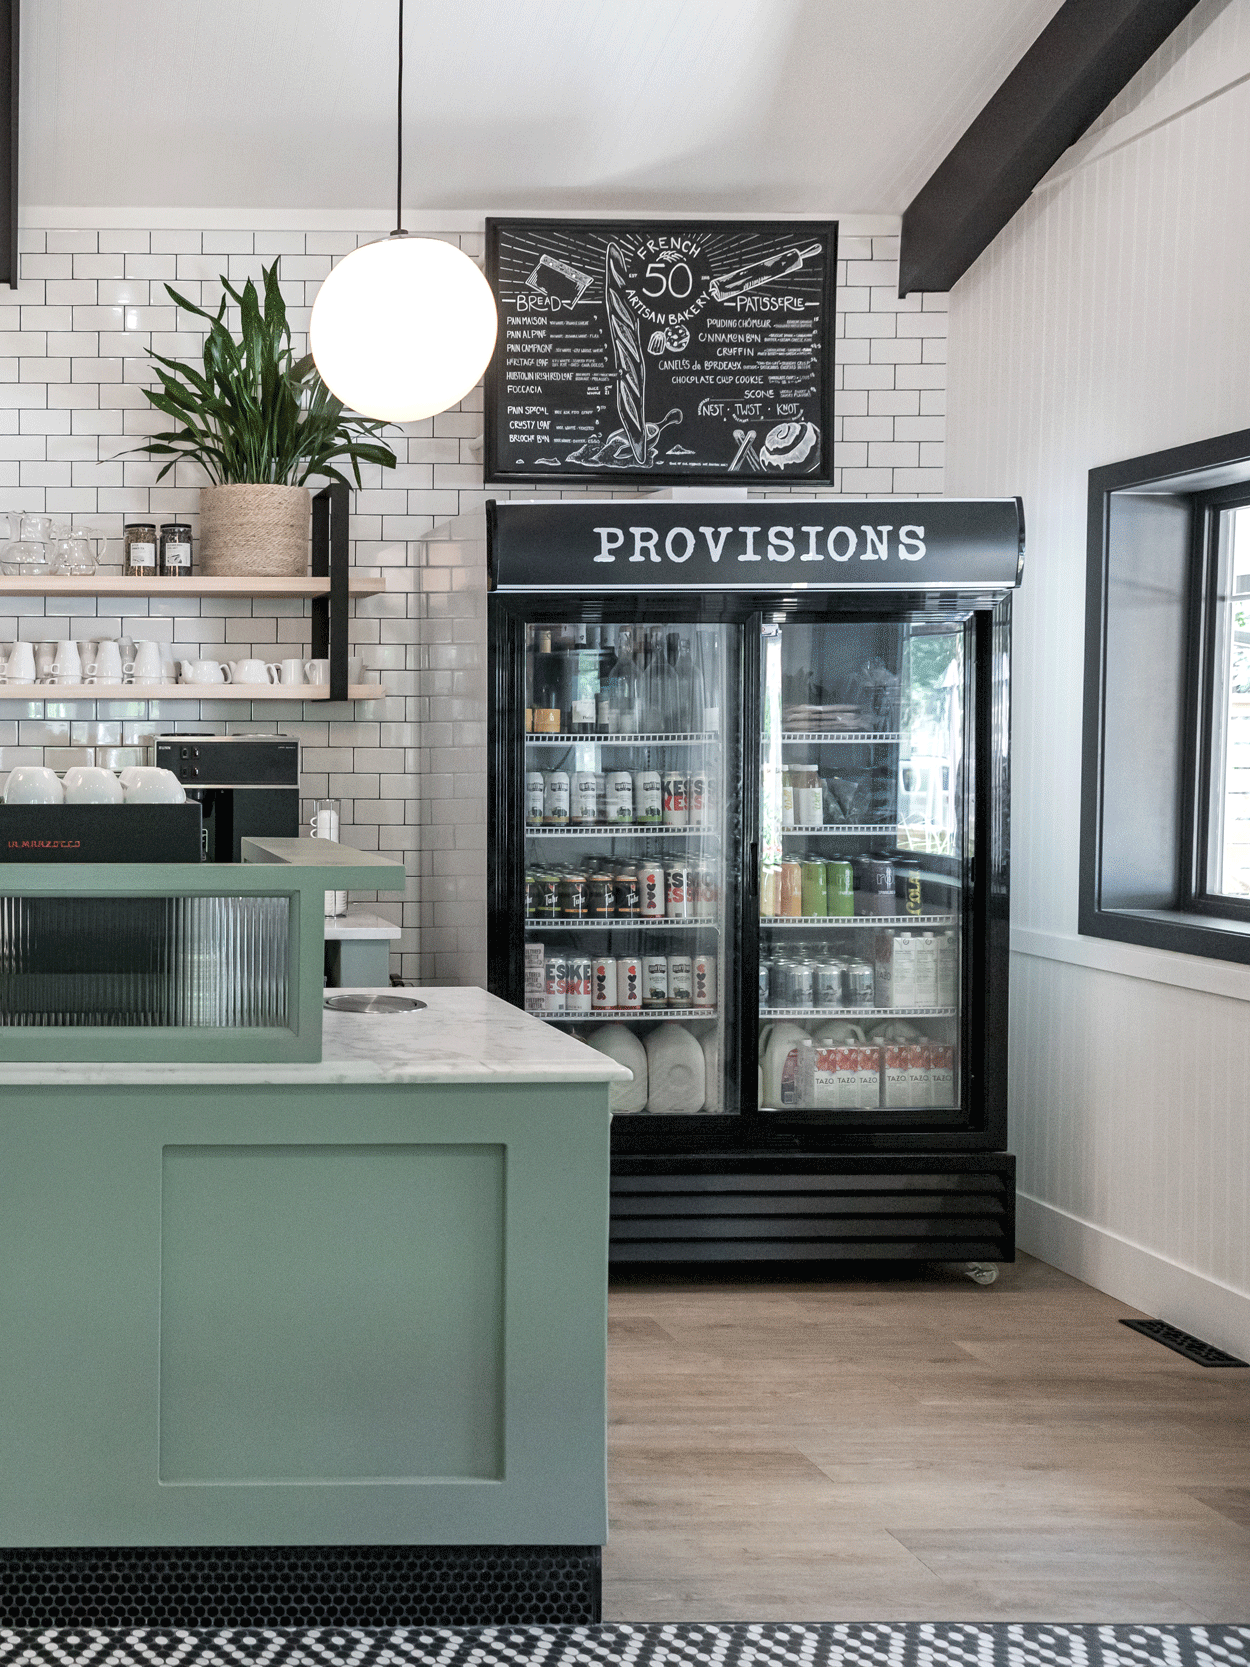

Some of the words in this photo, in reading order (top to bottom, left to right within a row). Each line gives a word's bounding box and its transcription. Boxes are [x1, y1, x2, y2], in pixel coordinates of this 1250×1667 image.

[637, 237, 701, 260] FRENCH
[642, 263, 693, 298] 50
[516, 294, 562, 312] BREAD
[625, 289, 666, 325] ARTISAN
[668, 291, 711, 325] BAKERY
[737, 296, 805, 312] PATISSERIE
[506, 316, 521, 325] PAIN
[522, 316, 548, 325] MAISON
[707, 318, 737, 328] POUDING
[506, 330, 521, 338] PAIN
[523, 329, 547, 338] ALPINE
[698, 332, 745, 342] CINNAMON
[746, 333, 761, 342] BUN
[506, 344, 521, 353] PAIN
[716, 348, 754, 356] CRUFFIN
[506, 358, 535, 367] HERITAGE
[672, 376, 714, 384] CHOCOLATE
[735, 376, 763, 384] COOKIE
[507, 385, 543, 393] FOCCACIA
[744, 390, 774, 398] SCONE
[507, 406, 523, 415] PAIN
[702, 404, 724, 416] NEST
[734, 404, 762, 415] TWIST
[776, 403, 799, 416] KNOT
[509, 420, 535, 430] CRUSTY
[509, 434, 535, 443] BRIOCHE
[536, 434, 550, 443] BUN
[593, 525, 927, 563] PROVISIONS
